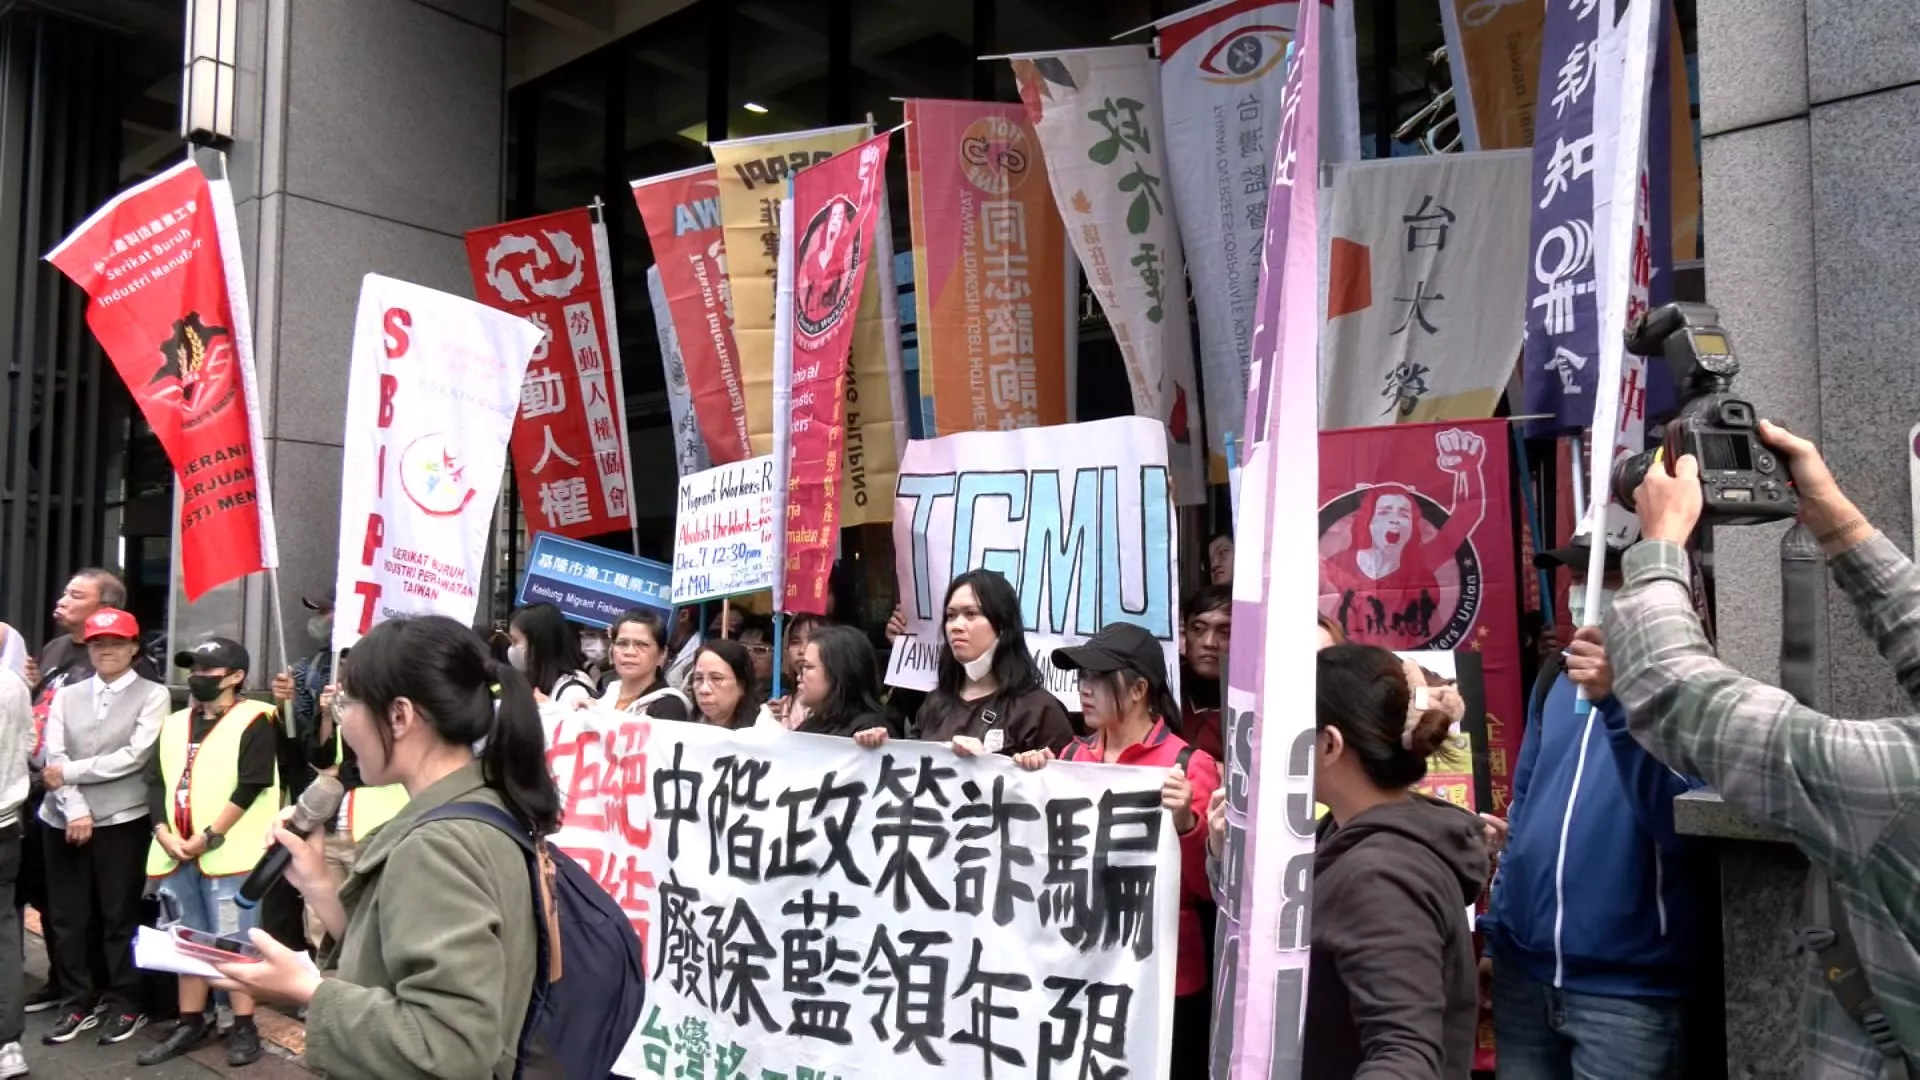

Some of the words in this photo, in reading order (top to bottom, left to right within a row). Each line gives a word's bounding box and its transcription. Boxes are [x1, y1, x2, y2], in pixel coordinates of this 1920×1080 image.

[106, 250, 153, 281] Serikat
[152, 228, 191, 256] Buruh
[97, 273, 151, 308] Industri
[1380, 195, 1456, 417] 台大勞
[568, 311, 629, 512] 勞動人權協會
[184, 467, 254, 504] ERJUA
[217, 491, 256, 512] MEN
[896, 465, 1173, 641] TGMU
[402, 580, 440, 600] TAIWAN
[687, 573, 715, 597] MOL
[1456, 572, 1478, 622] Union
[894, 633, 940, 676] TAIWA
[653, 742, 1165, 962] 中階政策詐騙
[653, 867, 1135, 1080] 廢除藍領年限
